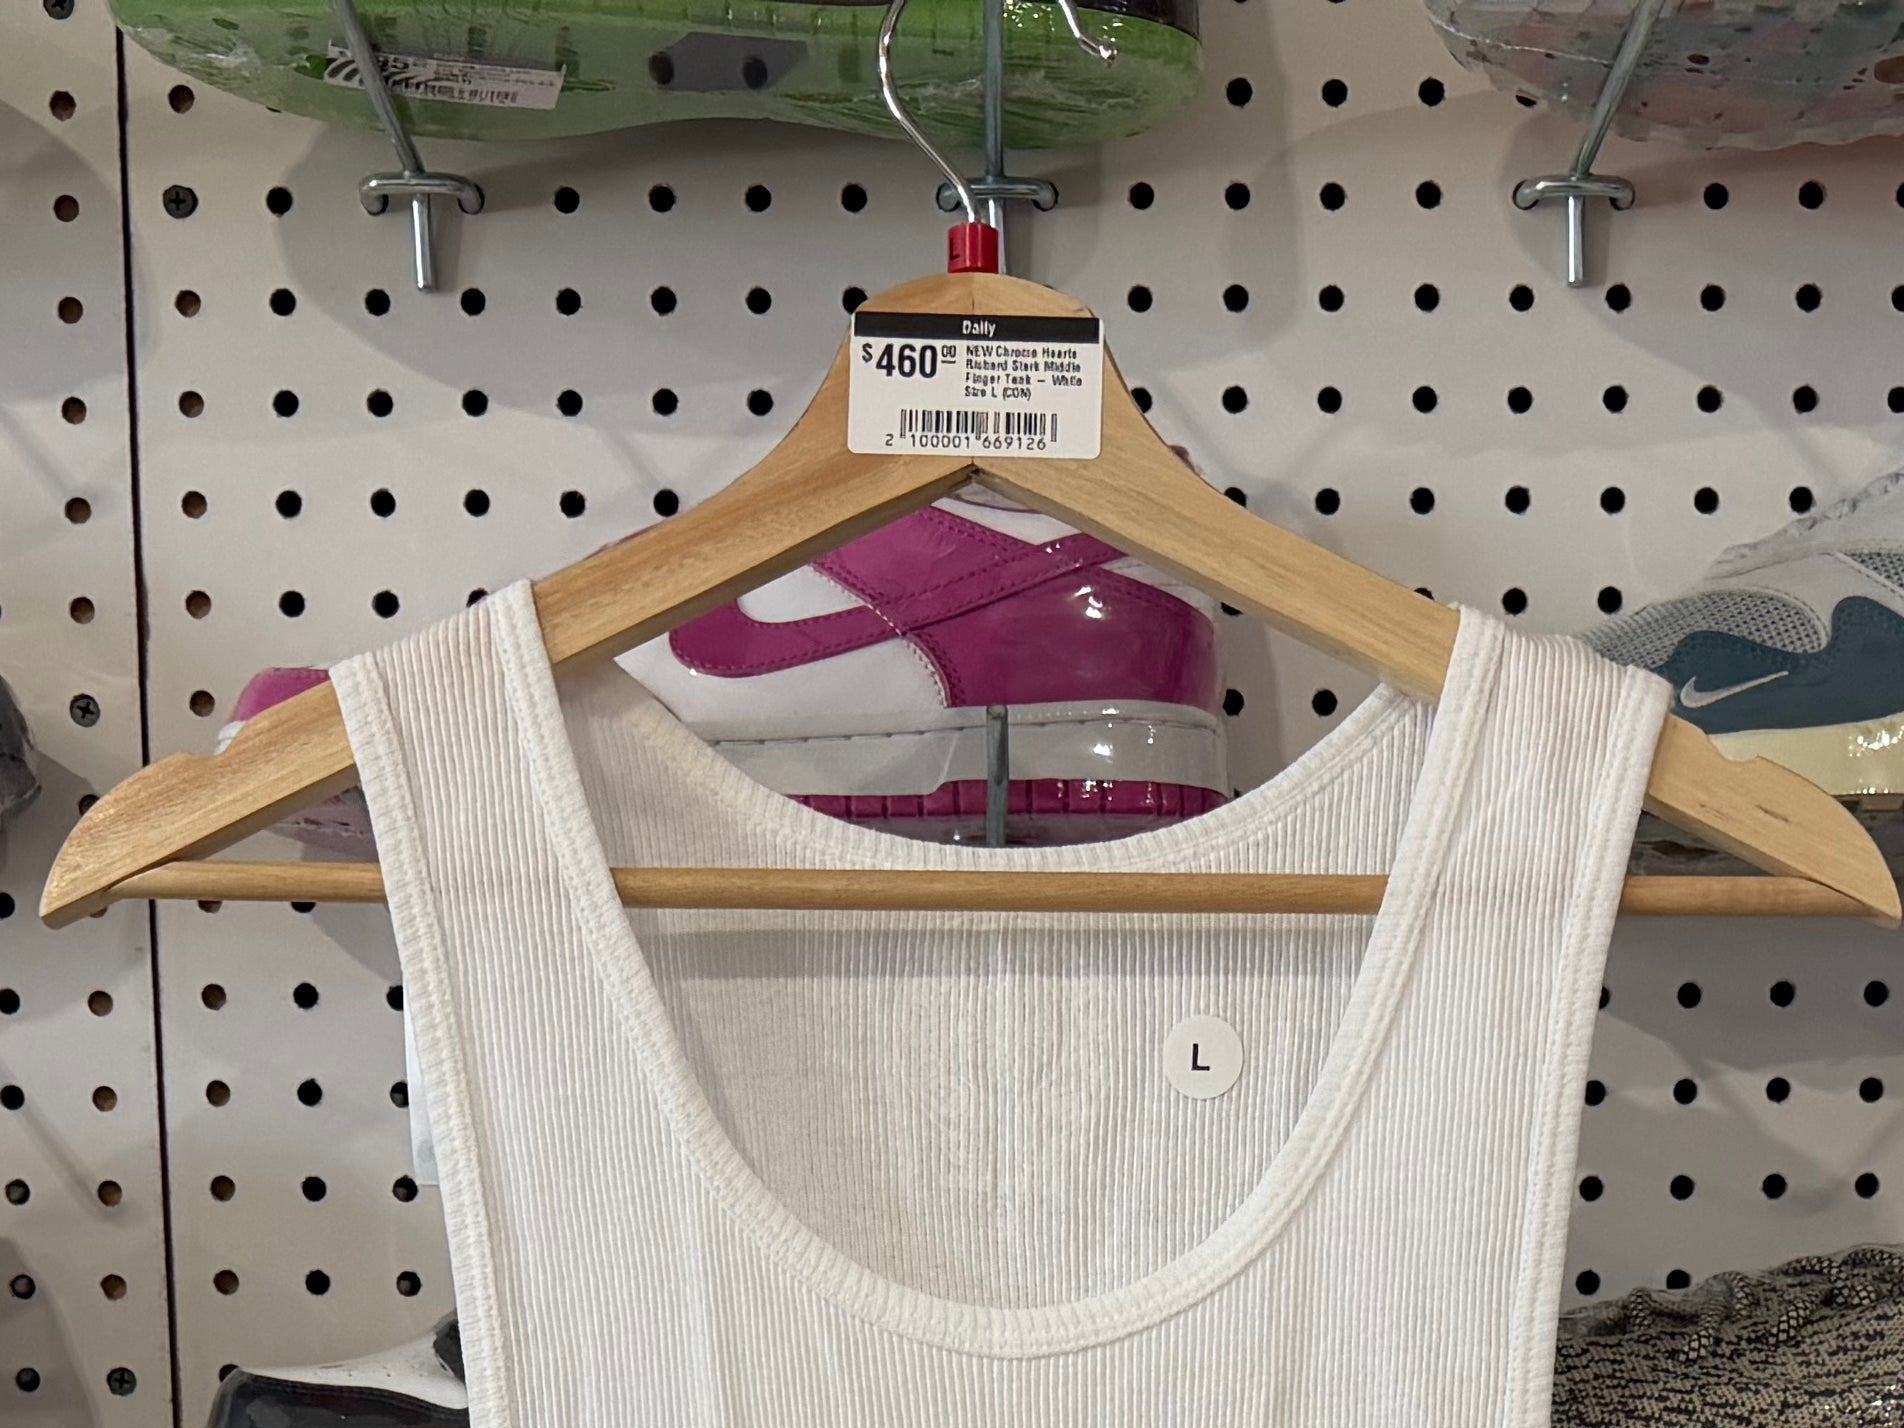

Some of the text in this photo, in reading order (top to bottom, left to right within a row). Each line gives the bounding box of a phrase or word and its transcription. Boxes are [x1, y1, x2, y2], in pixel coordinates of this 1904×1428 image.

[966, 344, 994, 358] NEW
[991, 386, 998, 398] L
[884, 433, 1047, 451] 2 100001 669126
[1191, 1042, 1211, 1072] L
